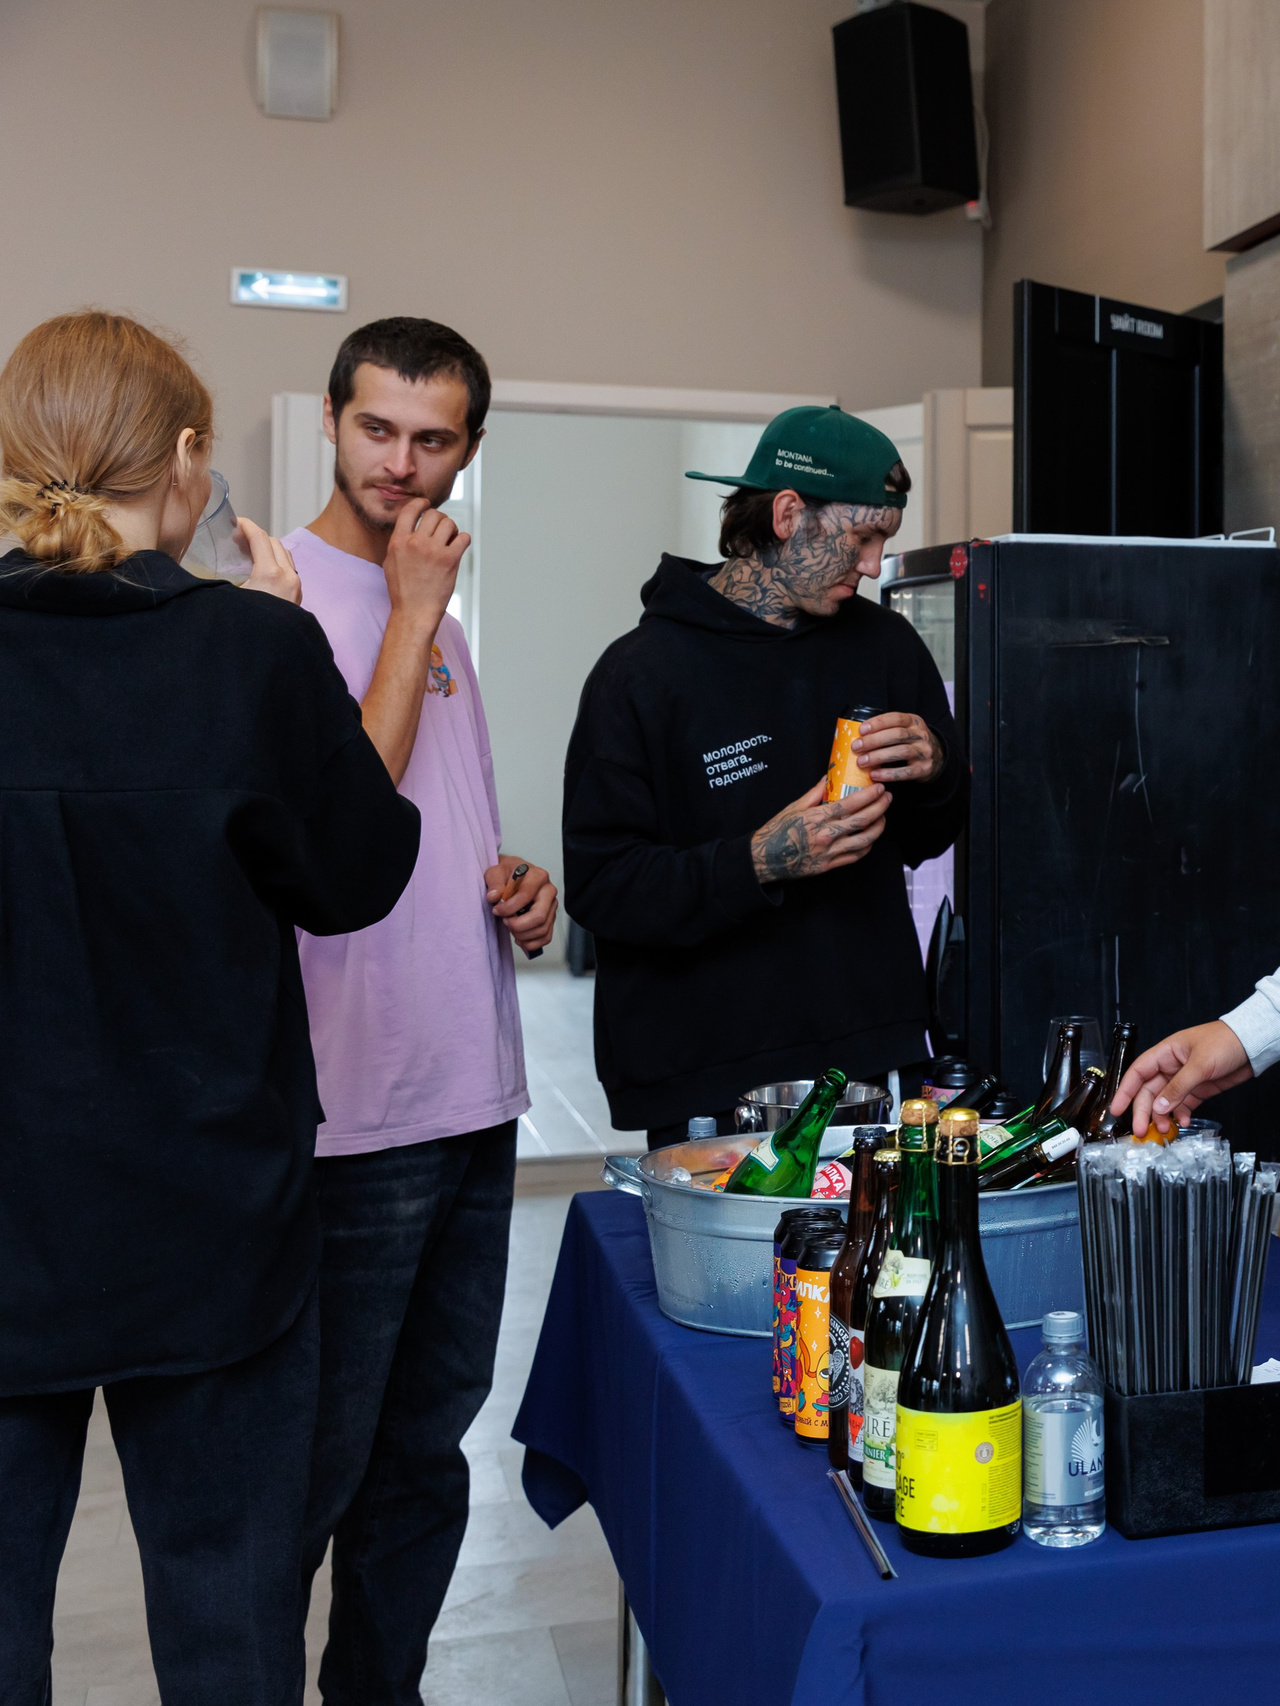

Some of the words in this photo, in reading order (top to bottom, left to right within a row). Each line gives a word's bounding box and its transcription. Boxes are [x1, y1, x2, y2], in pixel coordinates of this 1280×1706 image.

[777, 449, 813, 464] MONTANA
[775, 458, 783, 466] to
[783, 460, 793, 469] be
[793, 464, 835, 477] continued...
[706, 754, 752, 775] отвага.
[709, 761, 769, 789] гедонизм.
